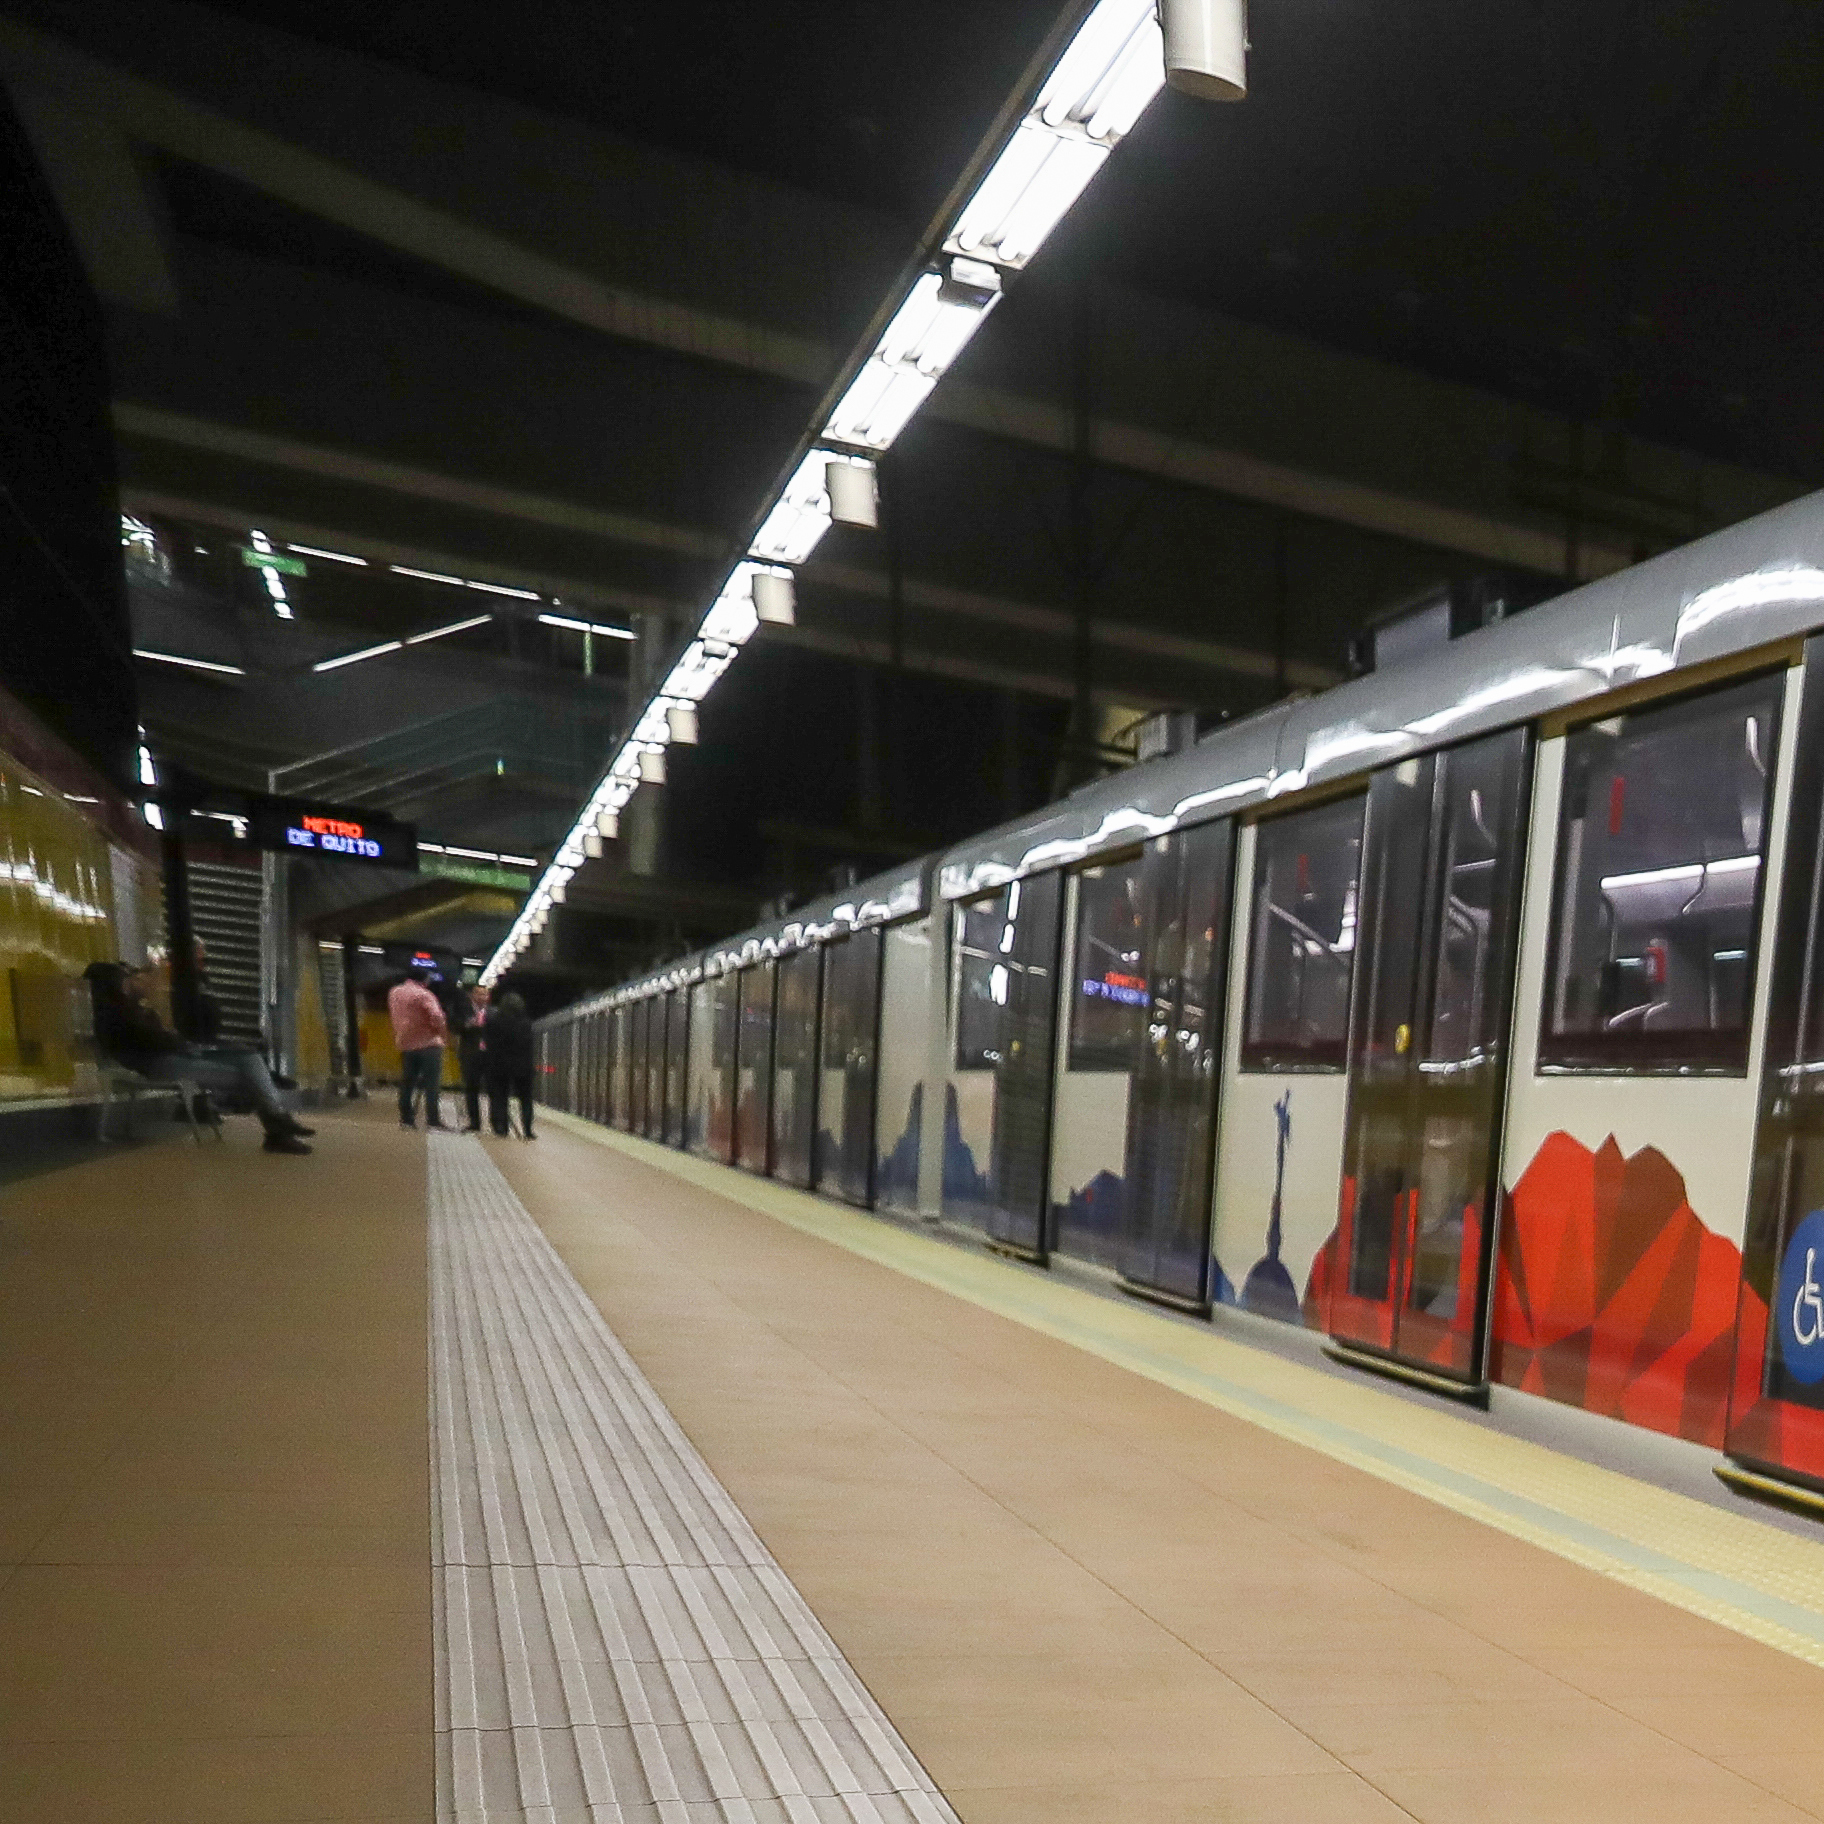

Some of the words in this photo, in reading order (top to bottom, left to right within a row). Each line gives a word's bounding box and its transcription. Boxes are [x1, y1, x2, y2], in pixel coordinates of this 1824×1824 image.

[302, 815, 364, 839] METRO
[286, 826, 315, 847] DE
[320, 833, 382, 858] QUITO
